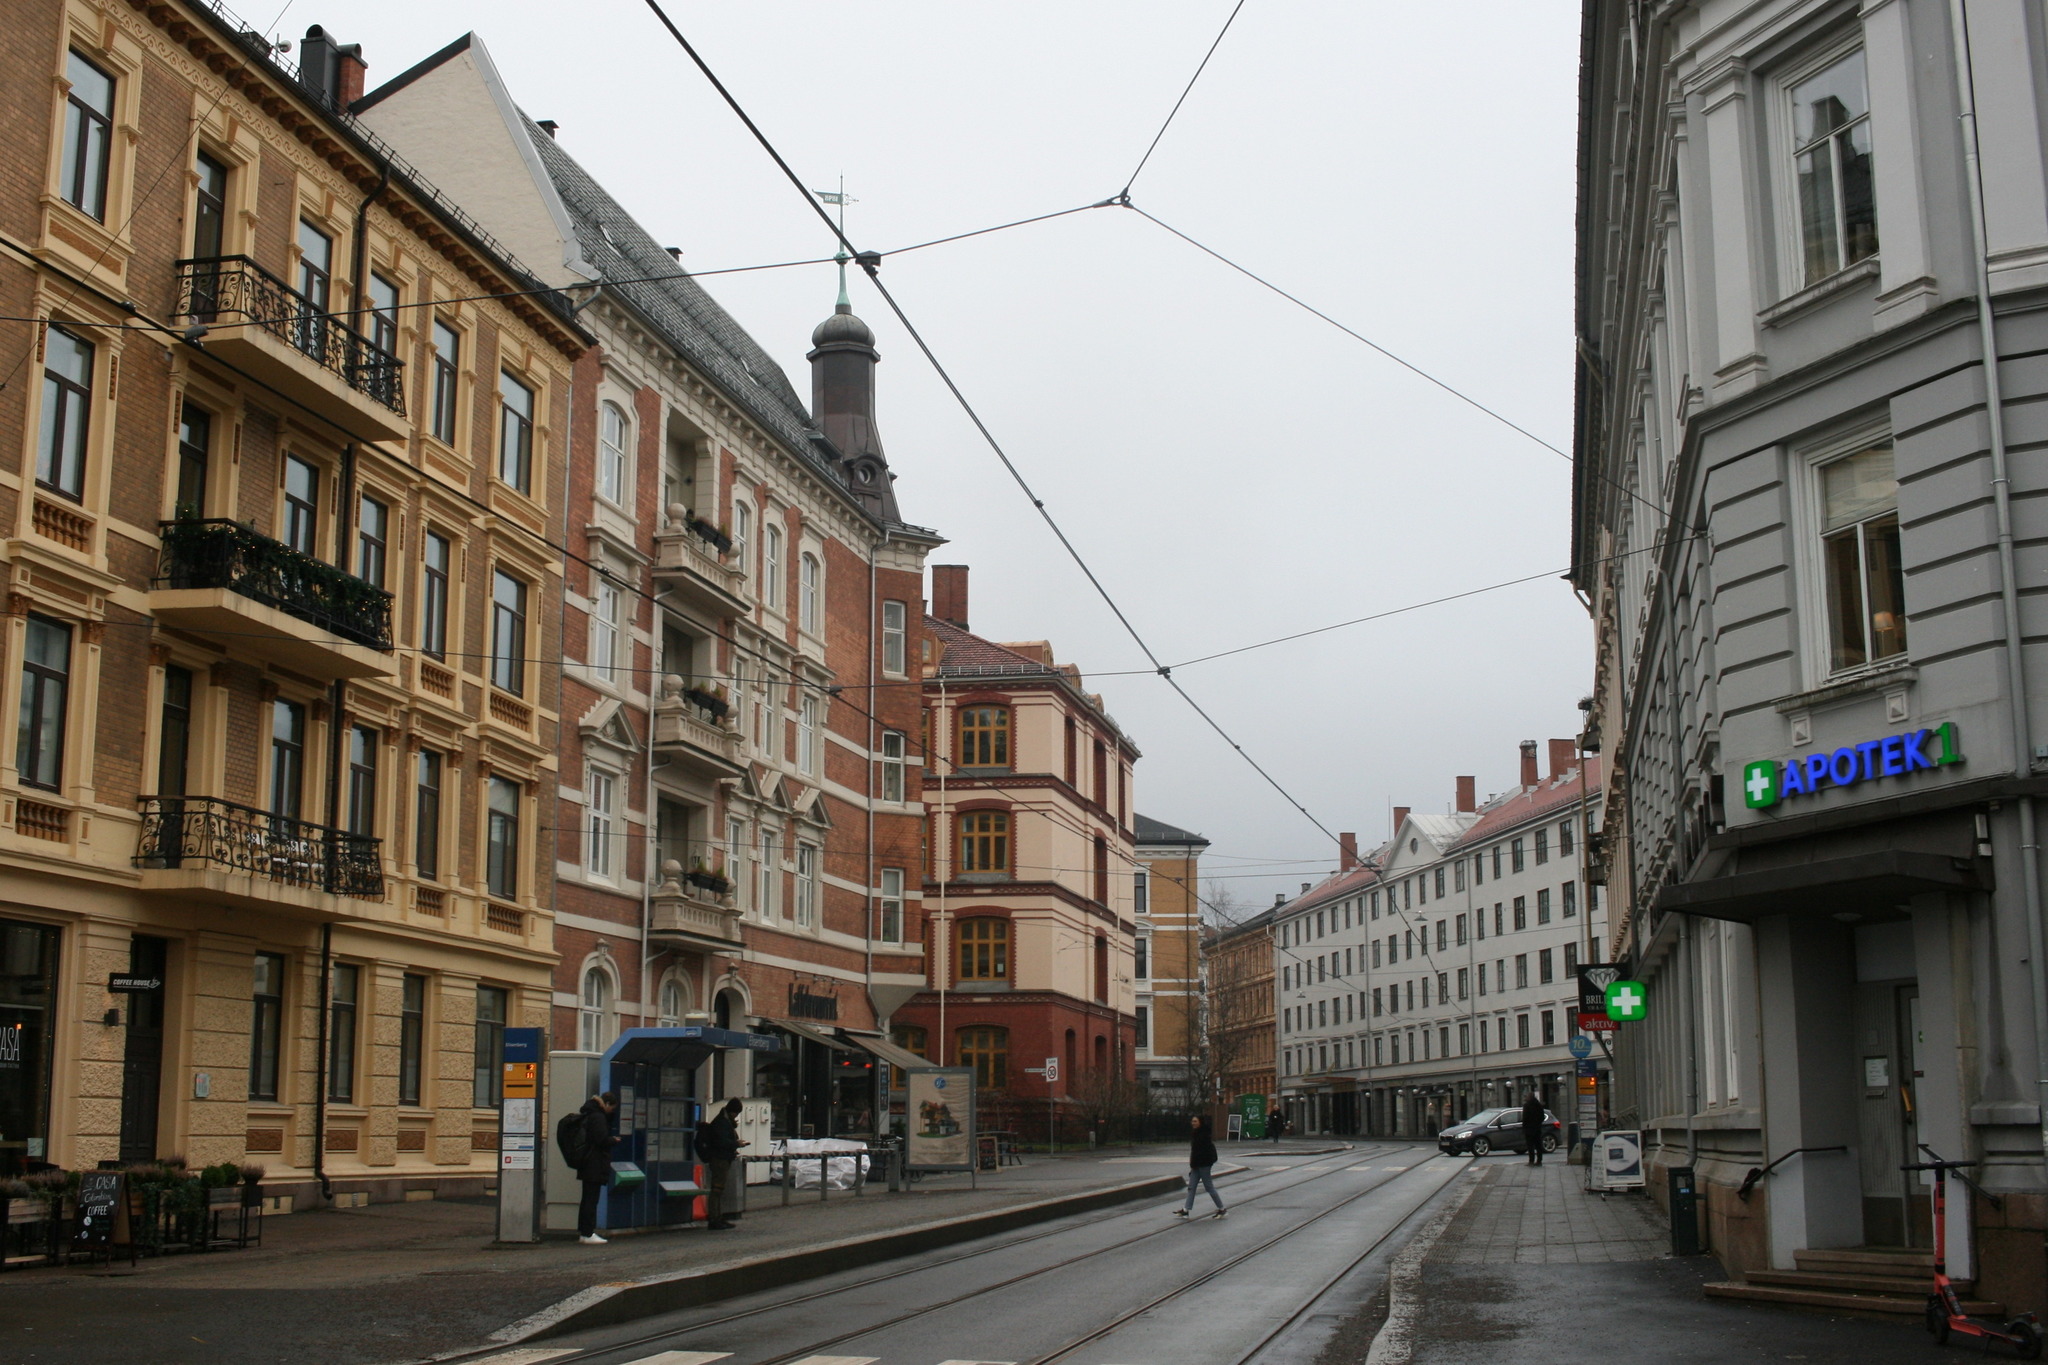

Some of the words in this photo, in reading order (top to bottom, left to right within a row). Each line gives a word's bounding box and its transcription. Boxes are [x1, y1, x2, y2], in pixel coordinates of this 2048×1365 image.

[1781, 728, 1932, 798] APOTEK
[113, 978, 132, 986] COFFEE
[132, 979, 151, 987] HOUSE
[0, 1026, 20, 1061] ASA
[1573, 1038, 1585, 1049] 10
[96, 1176, 116, 1190] CASA
[87, 1205, 108, 1216] COFFEE
